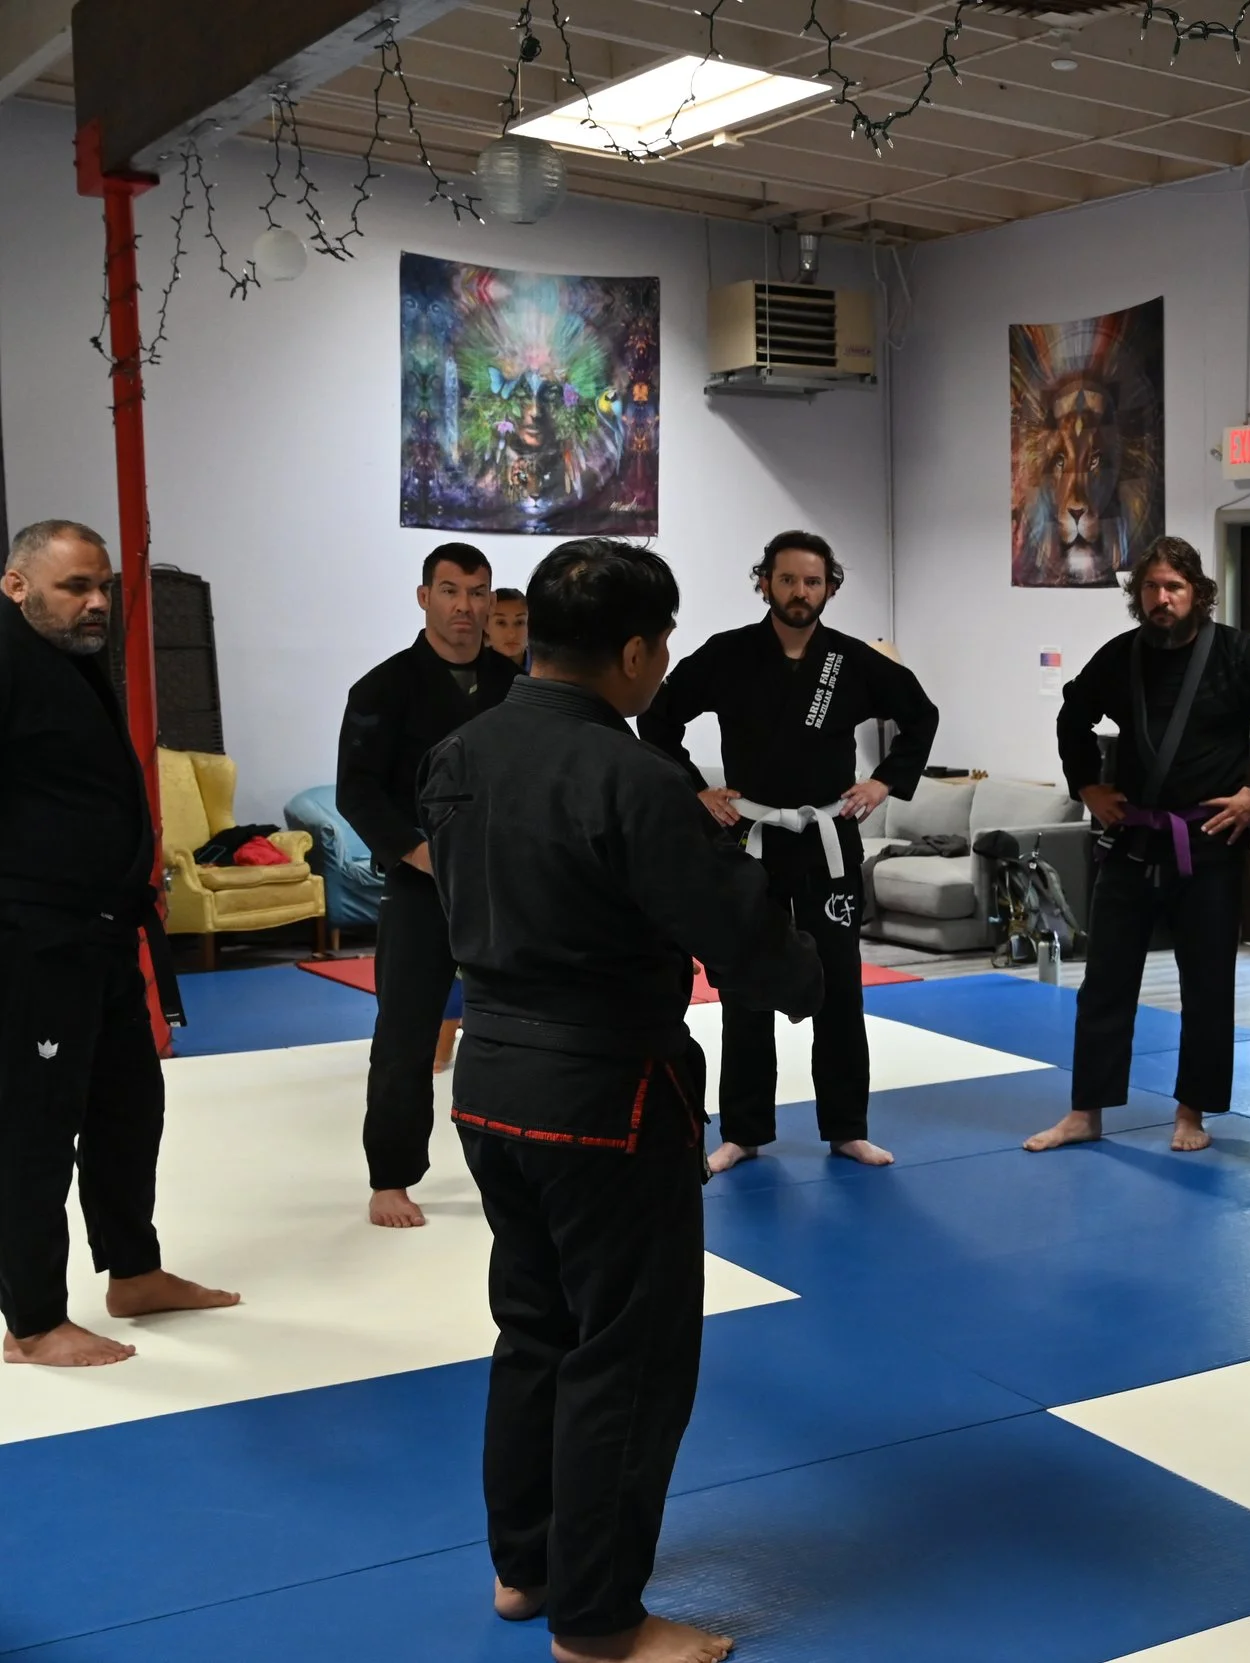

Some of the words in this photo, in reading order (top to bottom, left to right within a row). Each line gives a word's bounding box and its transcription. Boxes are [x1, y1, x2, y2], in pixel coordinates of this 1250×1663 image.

[804, 688, 825, 727] CARLOS
[819, 651, 837, 686] FARIAS
[814, 689, 833, 730] BRAZILIAN
[828, 653, 844, 689] JIU-JITSU
